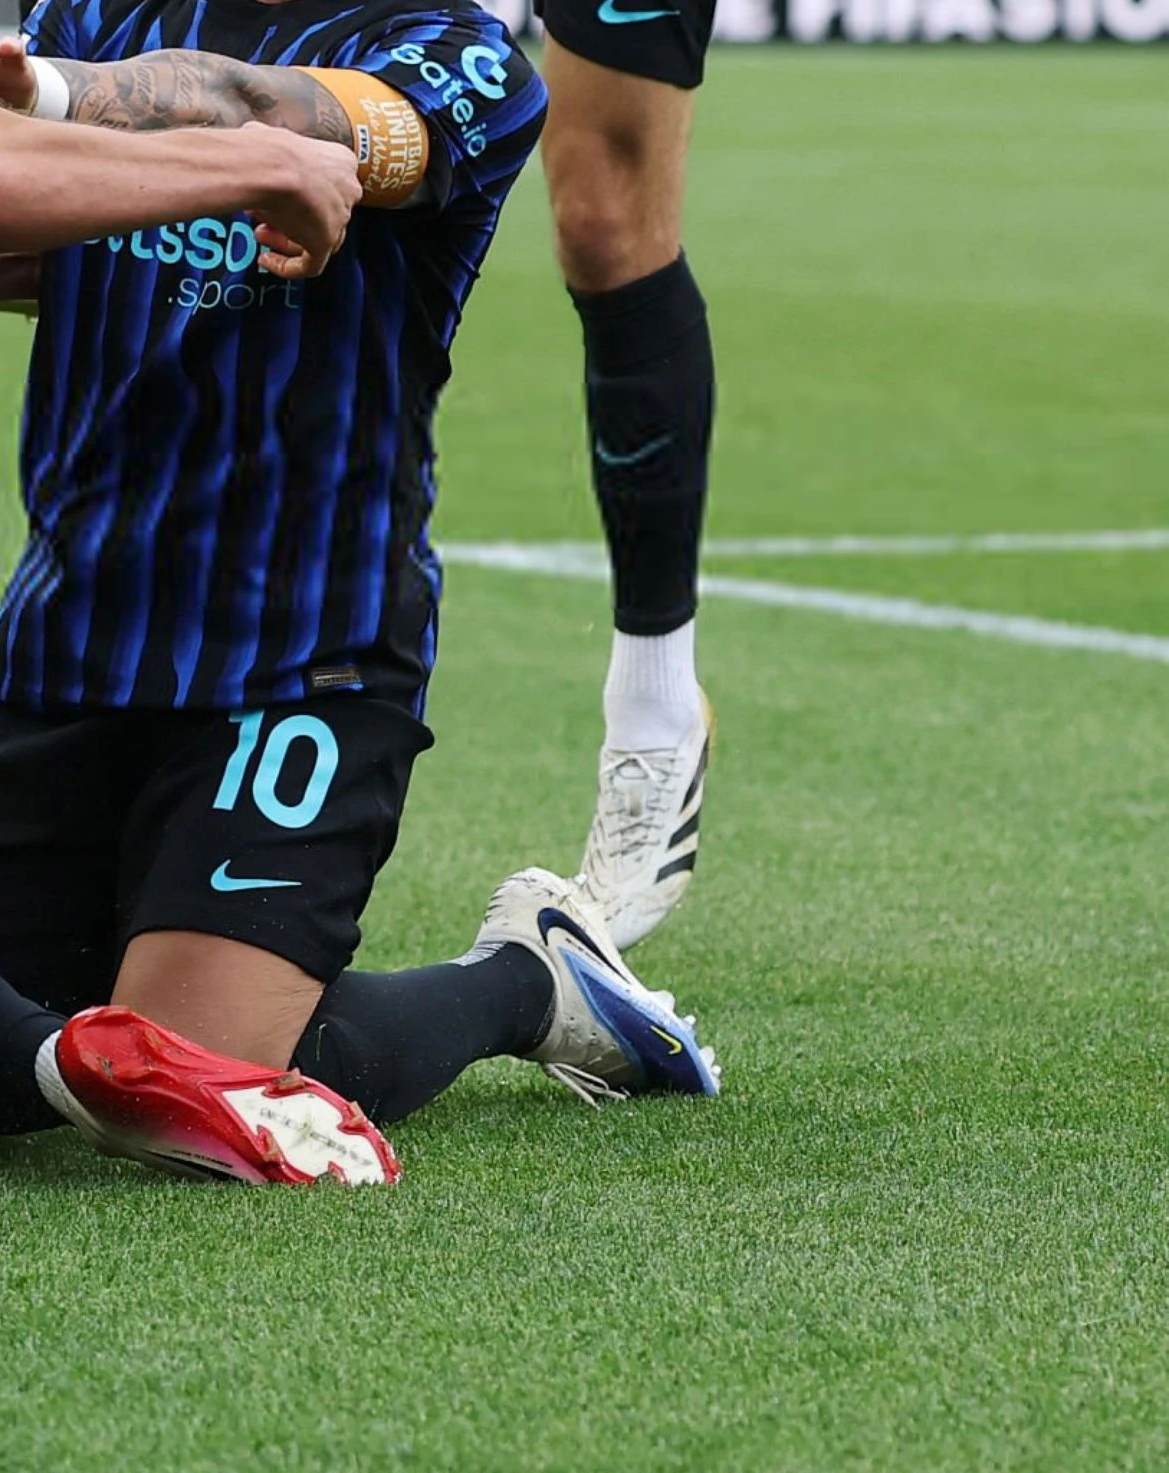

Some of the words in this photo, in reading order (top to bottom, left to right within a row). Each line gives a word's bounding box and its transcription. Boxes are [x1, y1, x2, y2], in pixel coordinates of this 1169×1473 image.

[357, 126, 370, 162] FIFA
[391, 43, 487, 157] Gate.io
[396, 99, 424, 186] FOOTBALL
[379, 101, 408, 190] UNITES
[168, 278, 300, 315] .sport
[213, 708, 339, 829] 10
